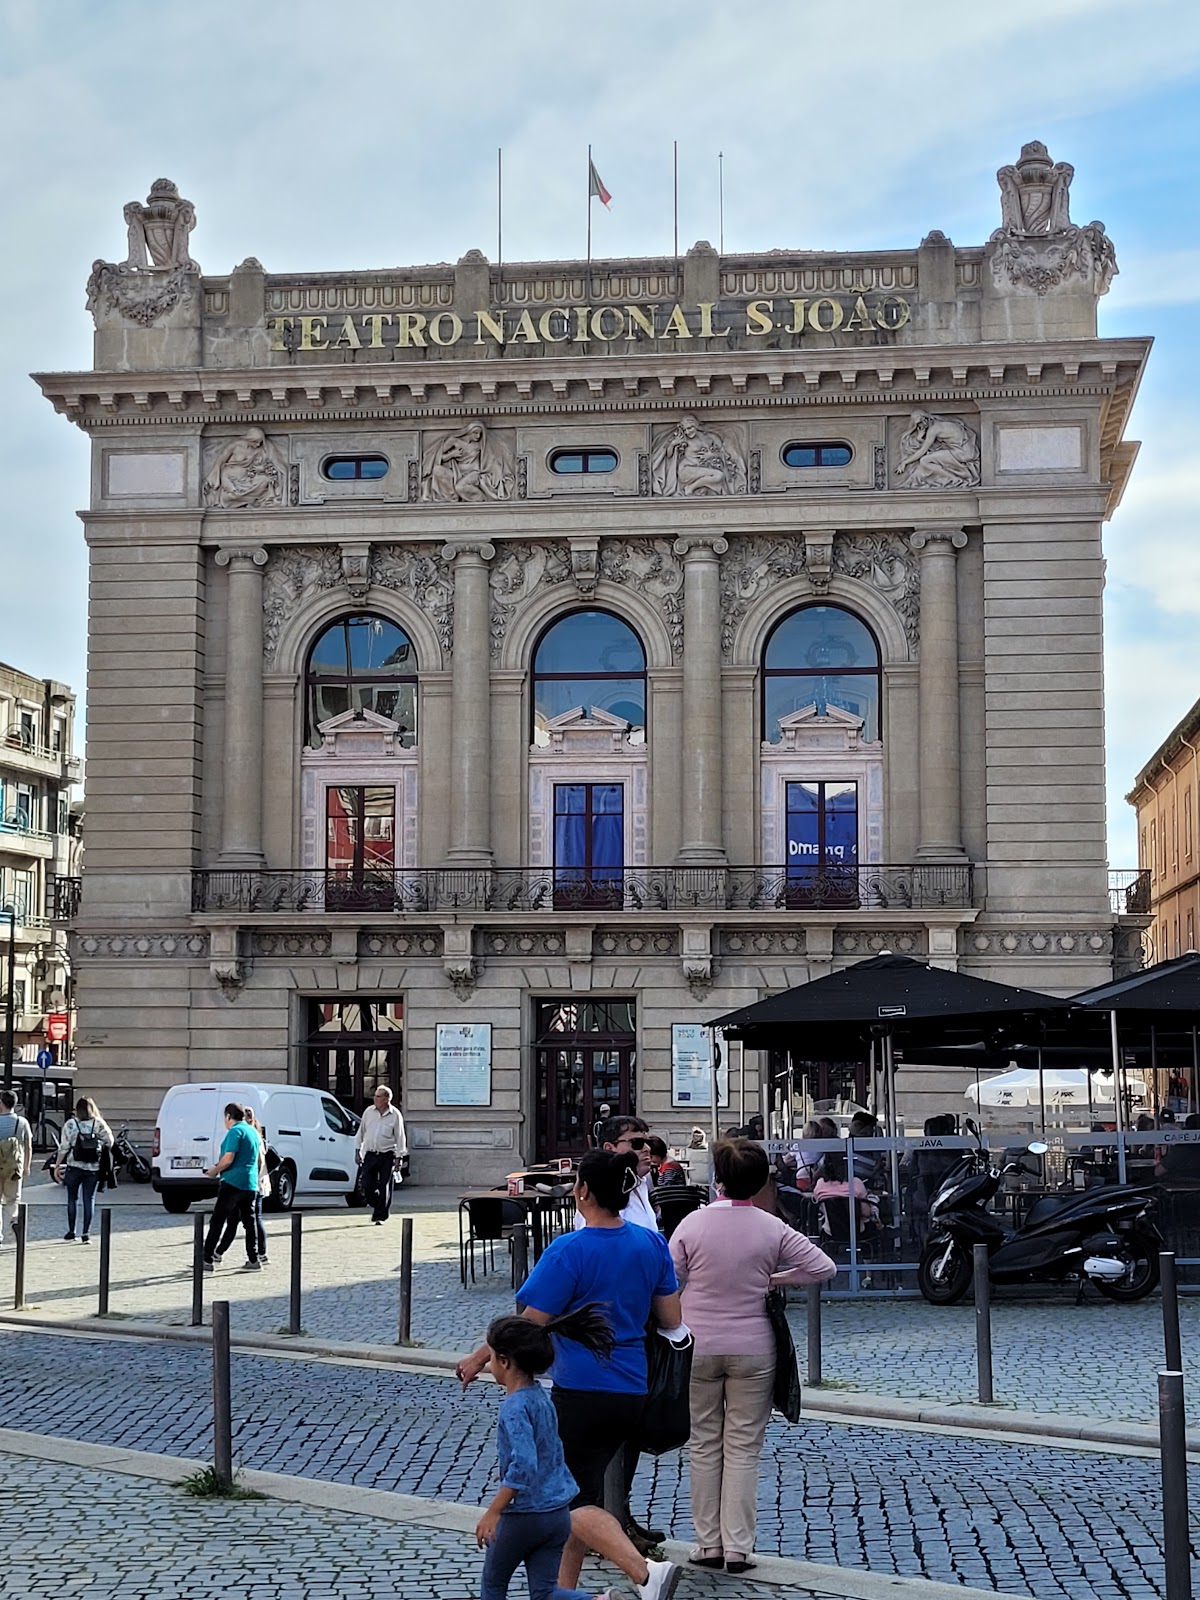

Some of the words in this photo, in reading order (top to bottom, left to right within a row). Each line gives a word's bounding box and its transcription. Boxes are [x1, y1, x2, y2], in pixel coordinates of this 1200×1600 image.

[266, 312, 463, 351] TEATRO
[473, 303, 731, 345] NACIONAL
[919, 1139, 943, 1147] JAVA
